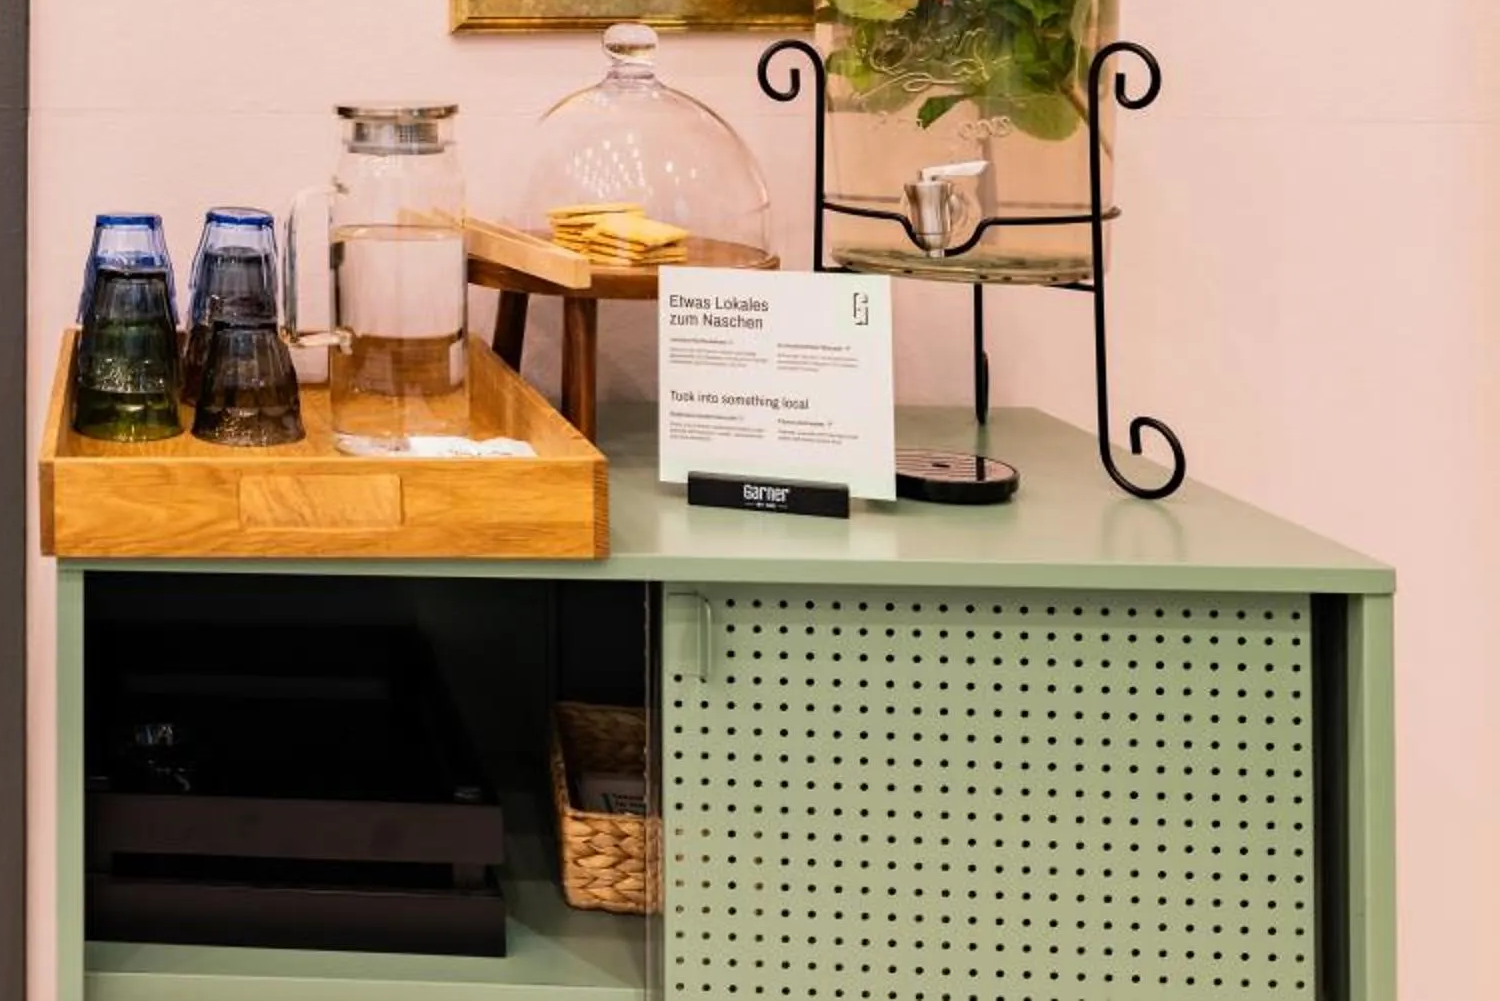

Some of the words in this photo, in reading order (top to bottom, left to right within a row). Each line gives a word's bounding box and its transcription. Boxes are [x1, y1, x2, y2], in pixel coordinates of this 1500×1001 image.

[669, 295, 711, 309] Etwas
[715, 296, 769, 312] Lokales
[669, 314, 699, 326] zum
[703, 313, 763, 329] Naschen
[671, 390, 694, 402] Tuck
[697, 392, 719, 404] into
[721, 394, 780, 410] something
[781, 398, 809, 410] local
[743, 484, 790, 503] Garner
